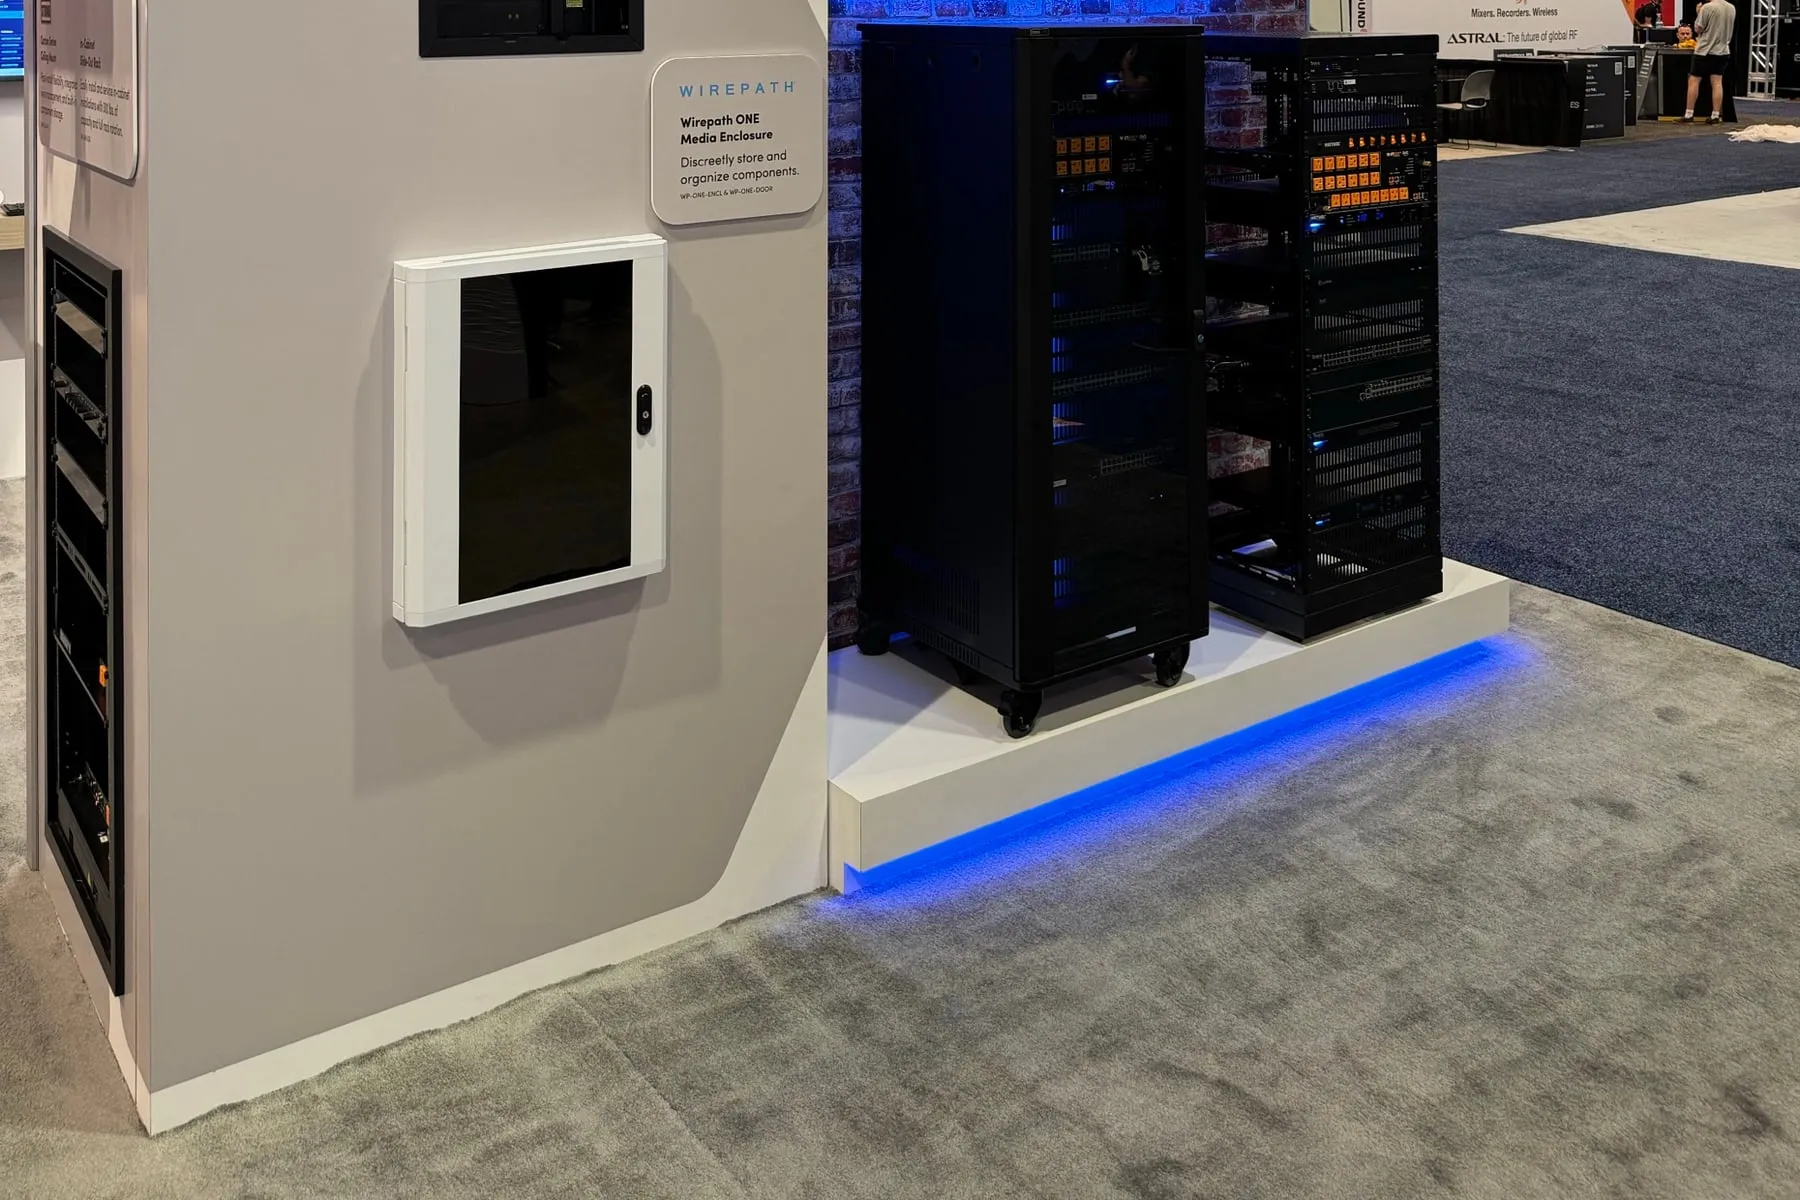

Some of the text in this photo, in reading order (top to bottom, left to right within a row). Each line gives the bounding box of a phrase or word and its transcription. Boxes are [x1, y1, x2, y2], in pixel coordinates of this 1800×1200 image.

[1532, 7, 1558, 17] Wireless
[1506, 32, 1519, 43] The
[1520, 32, 1540, 42] future
[1540, 31, 1548, 42] of
[1548, 30, 1568, 44] global
[679, 80, 795, 97] WIREPATH
[1569, 101, 1580, 109] ES
[680, 113, 760, 130] Wirepath ONE
[680, 130, 774, 145] Media Enclosure
[680, 149, 787, 168] Discreetly store and
[680, 166, 800, 187] organize components.
